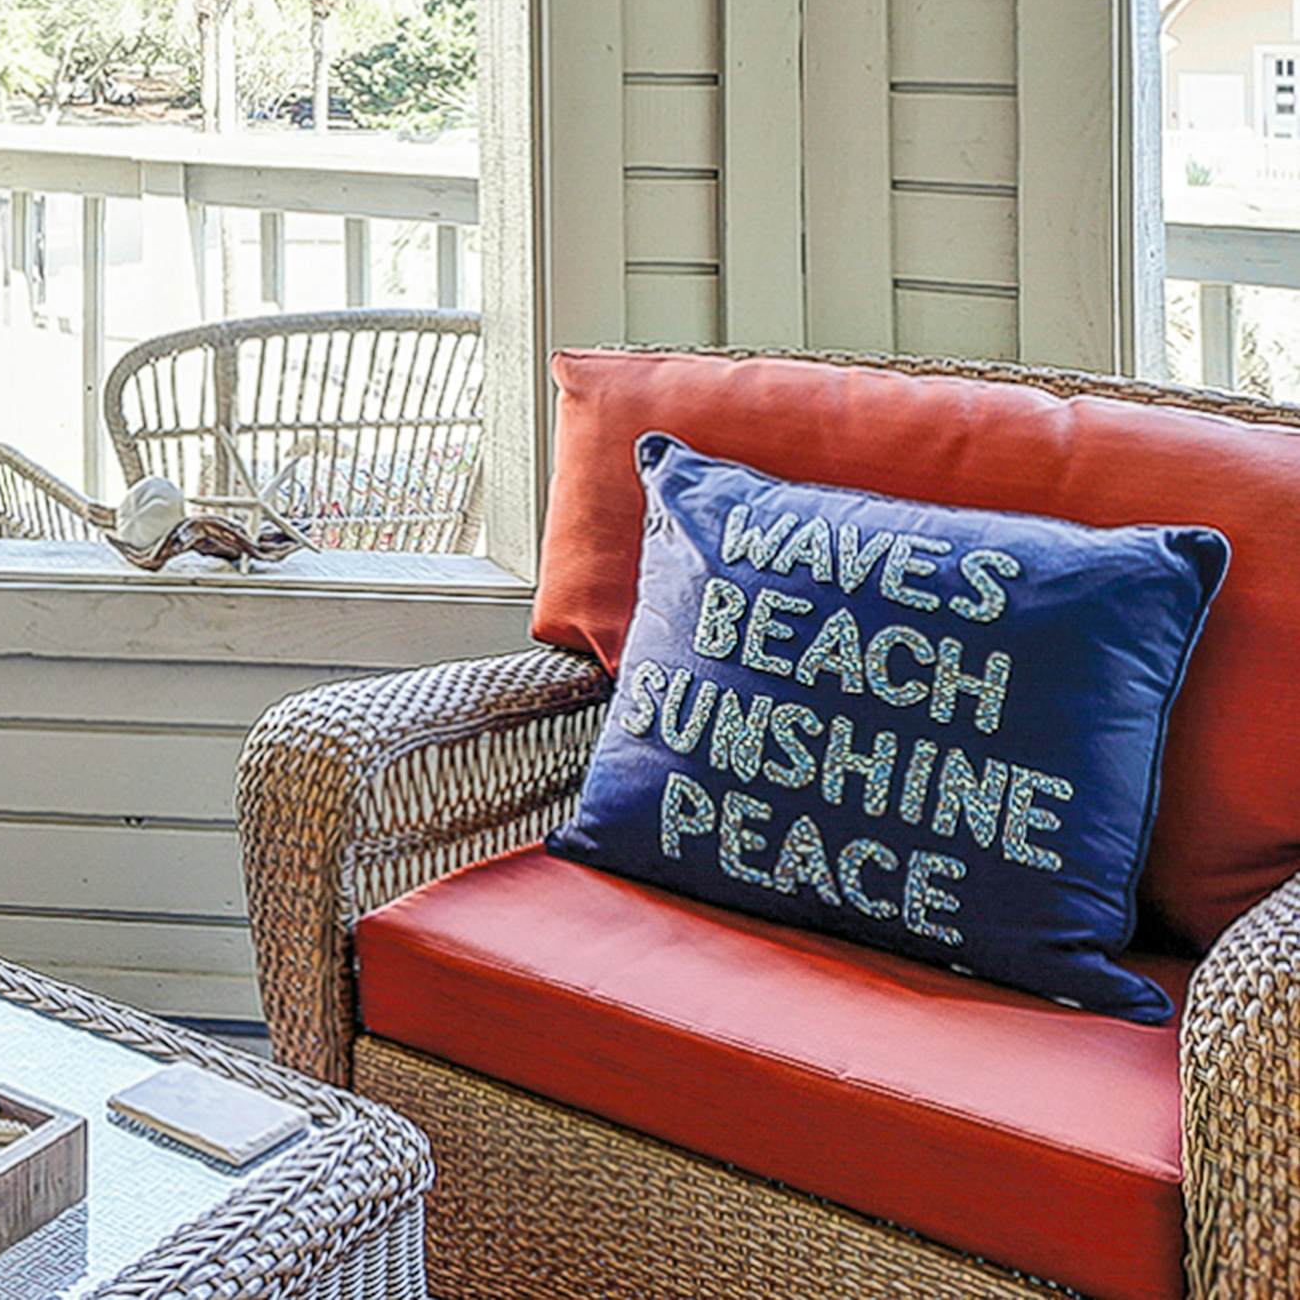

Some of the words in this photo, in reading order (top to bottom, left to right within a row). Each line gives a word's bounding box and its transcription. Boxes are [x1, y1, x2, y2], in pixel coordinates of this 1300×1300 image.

[718, 504, 1021, 623] WAVES
[694, 576, 1013, 733] BEACH
[620, 659, 1075, 872] SUNSHINE
[659, 771, 967, 947] PEACE
